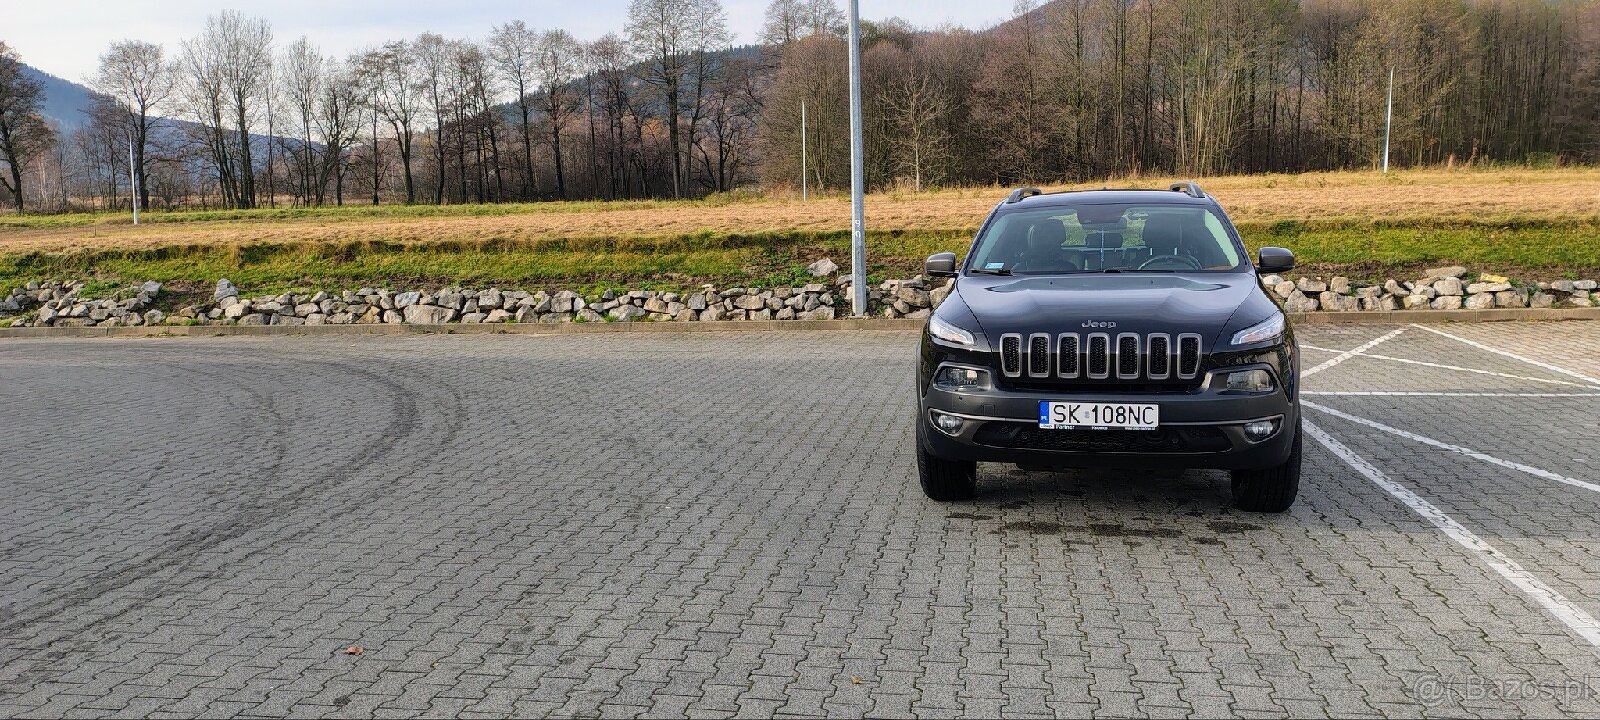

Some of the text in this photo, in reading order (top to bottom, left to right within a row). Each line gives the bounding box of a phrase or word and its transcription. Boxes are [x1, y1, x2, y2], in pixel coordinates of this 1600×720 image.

[1081, 319, 1117, 329] Jeep
[1053, 404, 1155, 425] SK 108NC
